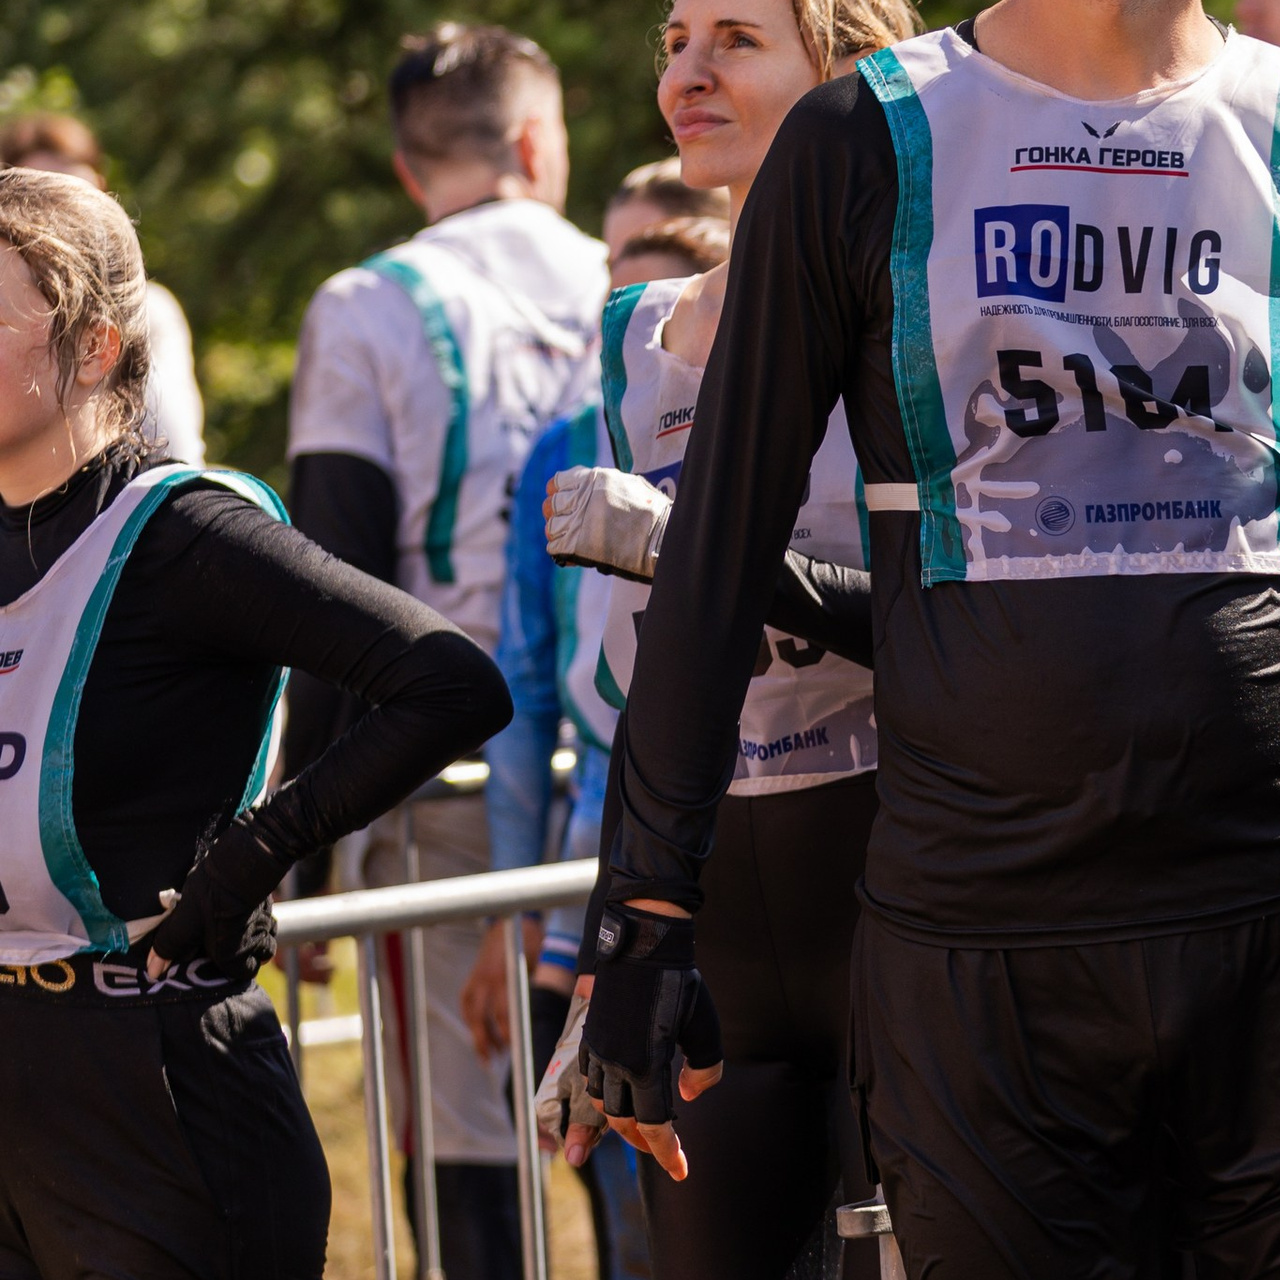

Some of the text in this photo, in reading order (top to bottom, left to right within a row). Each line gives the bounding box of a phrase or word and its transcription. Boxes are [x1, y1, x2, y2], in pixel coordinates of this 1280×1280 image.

[1014, 147, 1185, 169] ГОНКА ГЕРОЕВ
[984, 219, 1222, 295] RODVIG
[980, 303, 1034, 317] НАДЕЖНОСТЬ
[1114, 315, 1181, 328] БЛАГОСОСТОЯНИЕ
[1182, 316, 1200, 329] ДЛЯ
[1200, 316, 1220, 328] ВСЕХ
[658, 406, 695, 432] ГОНК
[1085, 498, 1223, 524] ГАЗПРОМБАНК
